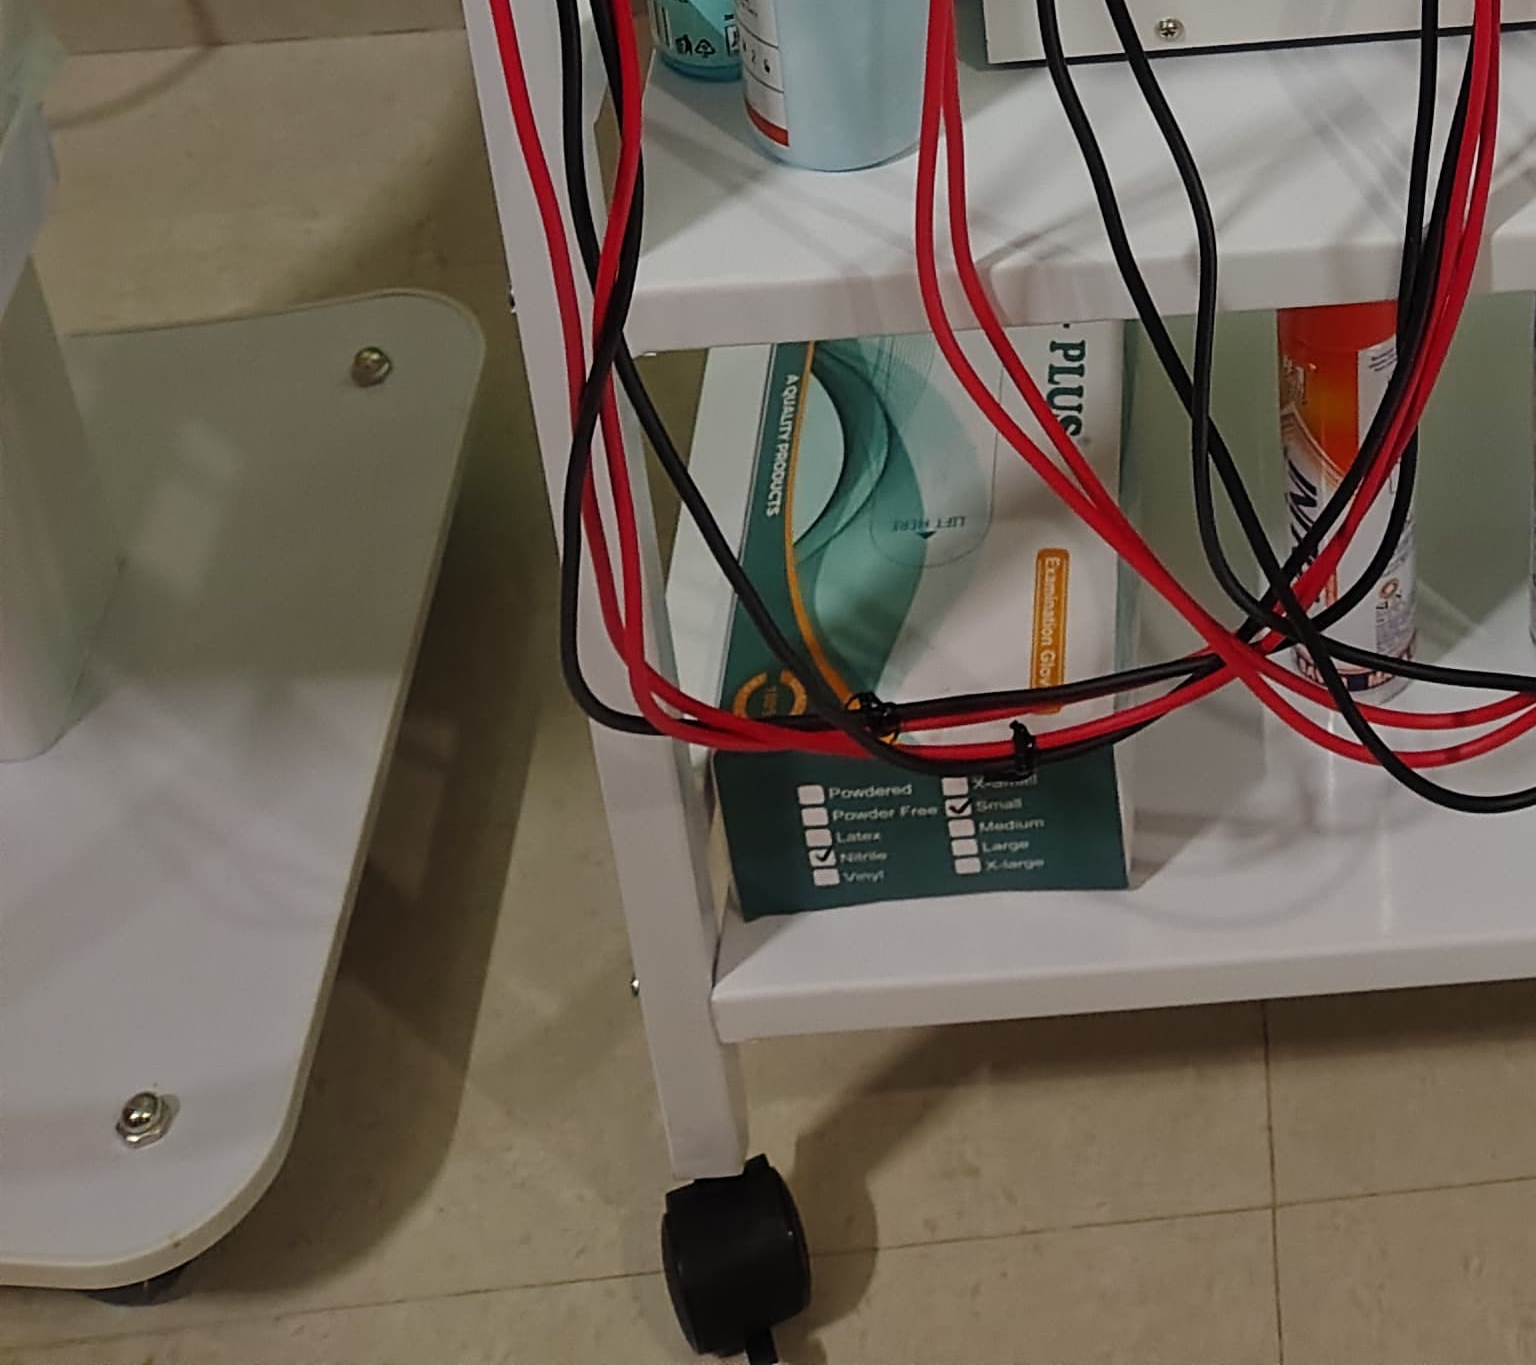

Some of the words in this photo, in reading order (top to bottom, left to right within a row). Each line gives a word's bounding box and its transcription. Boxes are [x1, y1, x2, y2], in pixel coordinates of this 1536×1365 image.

[786, 374, 800, 384] A
[778, 385, 798, 441] QUALITY
[766, 442, 790, 518] PRODUCTS
[1040, 556, 1061, 646] Examination
[828, 783, 913, 800] Powdered
[975, 797, 1023, 812] Small
[832, 808, 895, 822] Powder
[900, 805, 939, 817] Free
[978, 819, 1045, 833] Medium
[835, 831, 881, 844] Latex
[982, 840, 1030, 855] Large
[840, 851, 888, 864] Nitrile
[985, 858, 1045, 872] X-large
[842, 870, 885, 884] Vinyl
